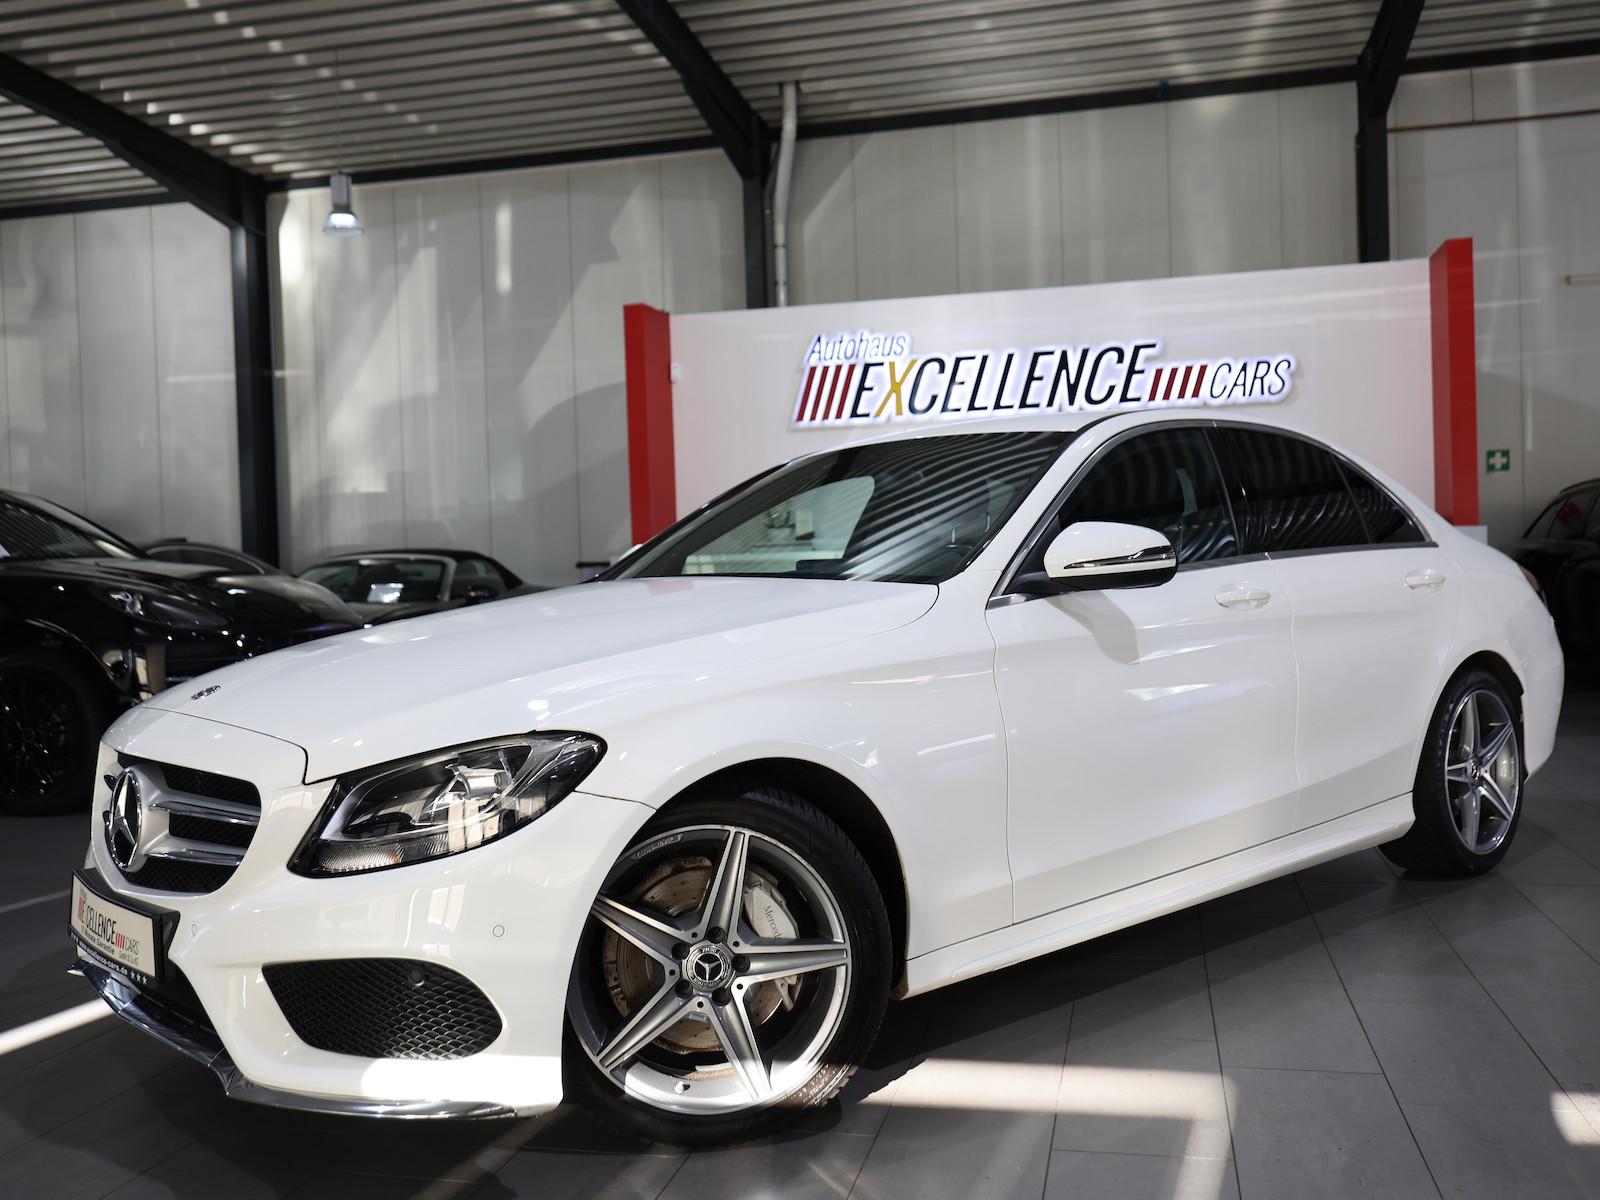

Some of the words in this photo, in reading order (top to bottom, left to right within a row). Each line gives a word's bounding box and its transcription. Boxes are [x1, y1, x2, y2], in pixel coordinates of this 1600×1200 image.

[807, 332, 906, 361] Autohaus
[849, 343, 1157, 418] EXCELLENCE
[1210, 359, 1291, 399] CARS
[81, 900, 117, 945] ECELLENCE
[125, 936, 140, 957] CARS
